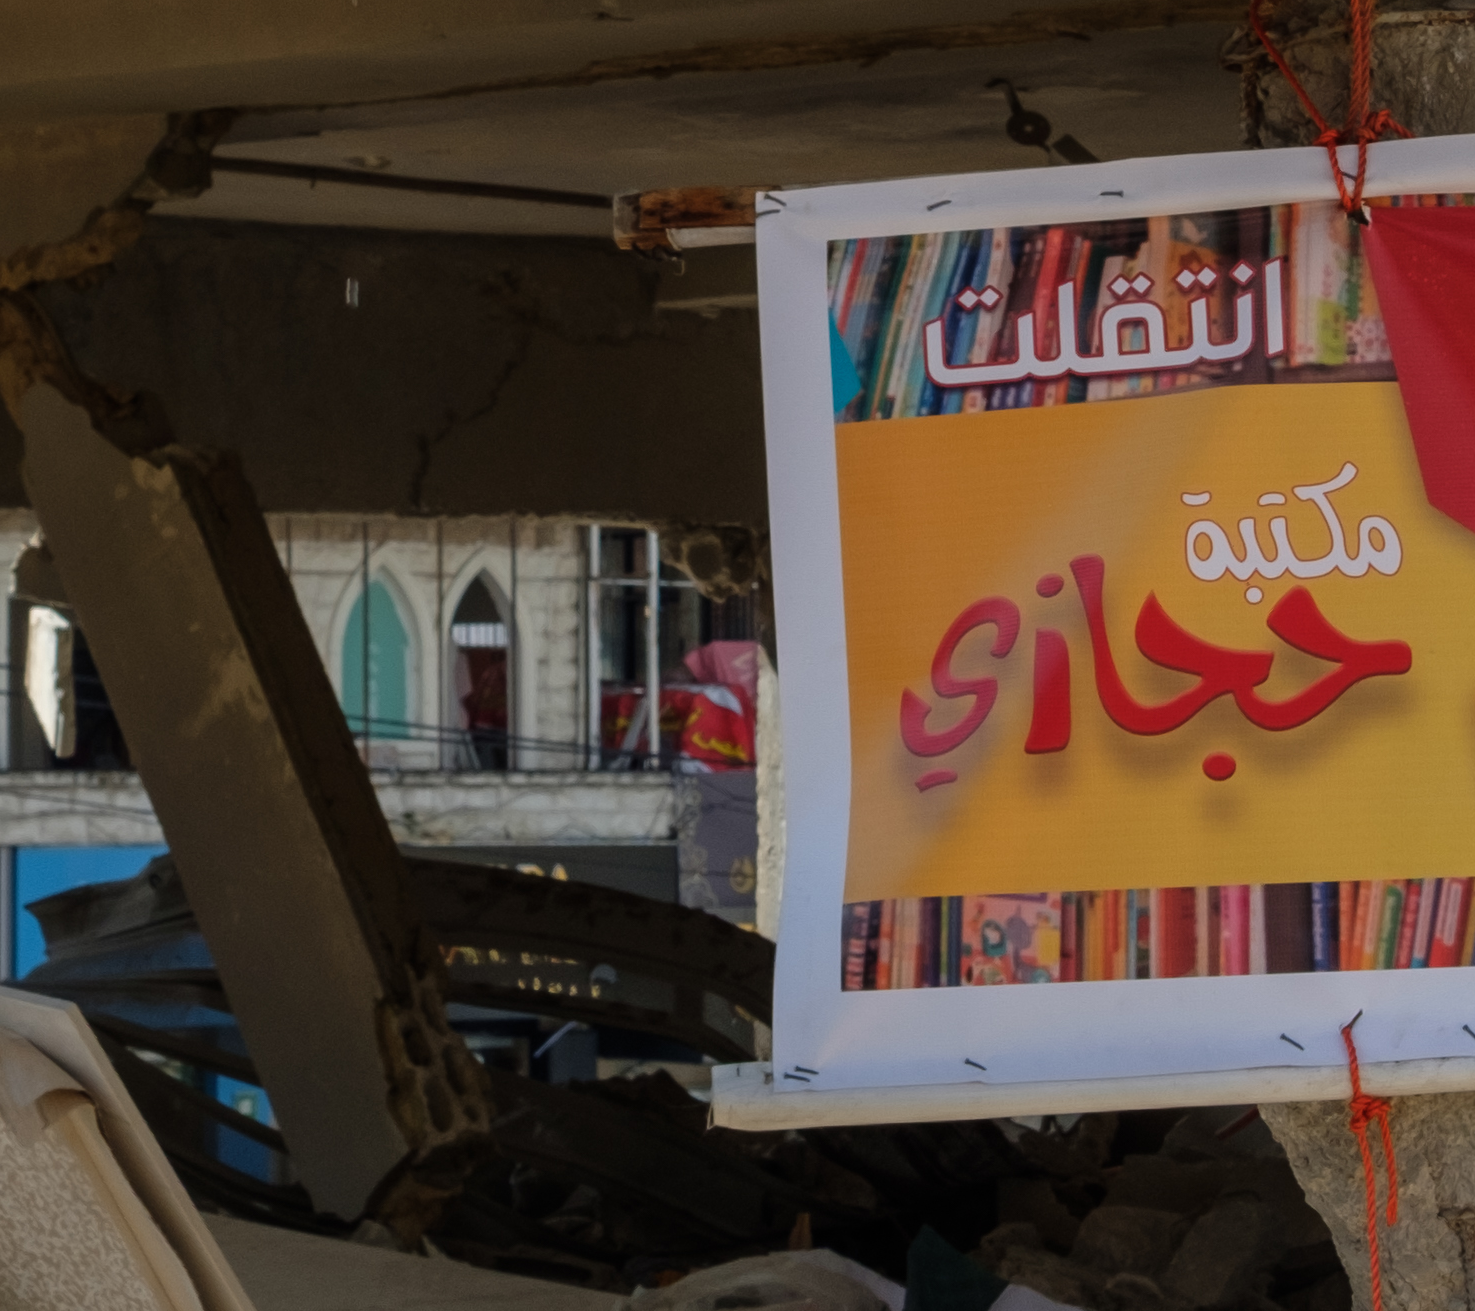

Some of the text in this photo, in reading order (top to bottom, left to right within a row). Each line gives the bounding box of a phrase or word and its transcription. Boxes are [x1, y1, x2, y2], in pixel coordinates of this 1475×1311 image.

[925, 255, 1285, 388] انتقلت
[1180, 461, 1403, 605] مكتبة
[900, 554, 1412, 793] حجازي
